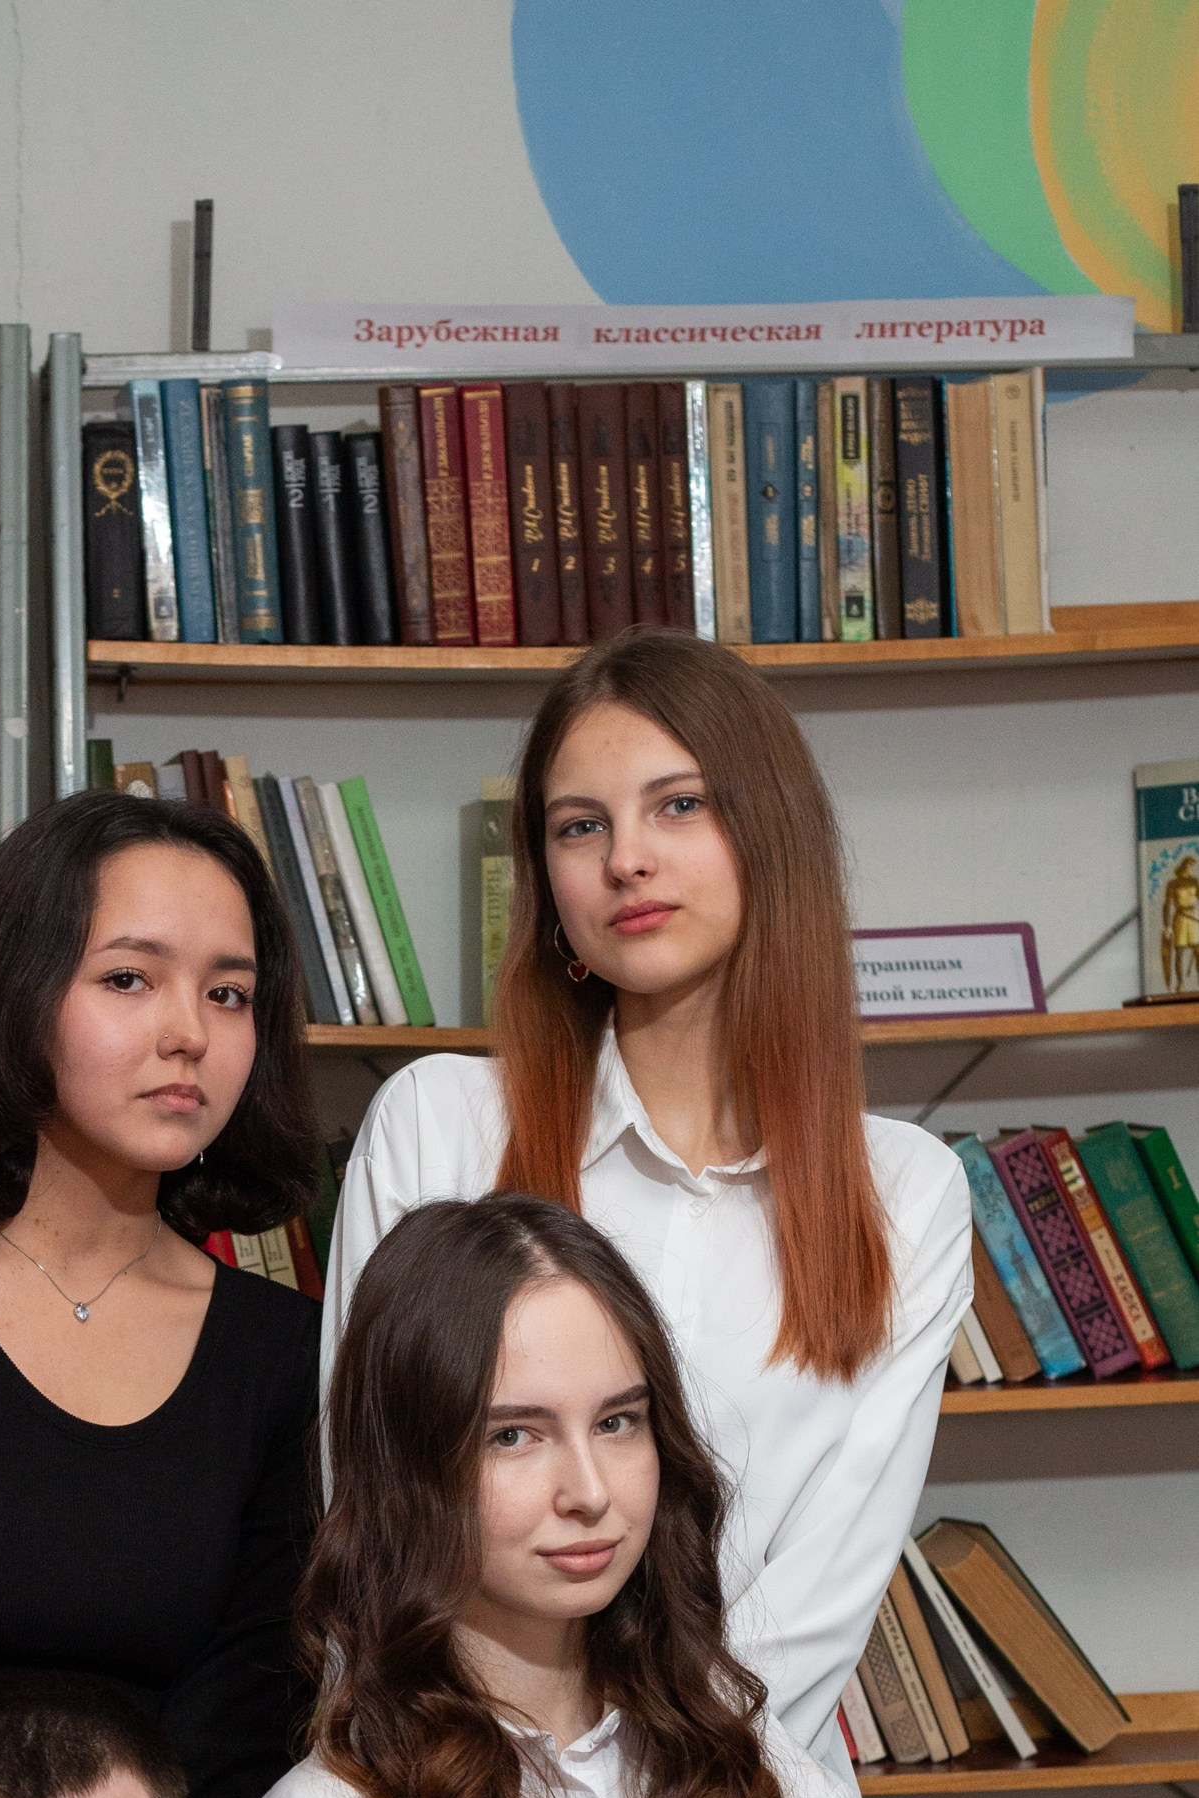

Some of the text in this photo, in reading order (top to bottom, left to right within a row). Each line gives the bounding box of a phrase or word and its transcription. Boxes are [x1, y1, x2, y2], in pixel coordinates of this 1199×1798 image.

[353, 314, 1046, 348] Зарубежная классическая литература
[286, 487, 305, 509] 2
[359, 493, 379, 515] 2
[911, 984, 1009, 1001] классики
